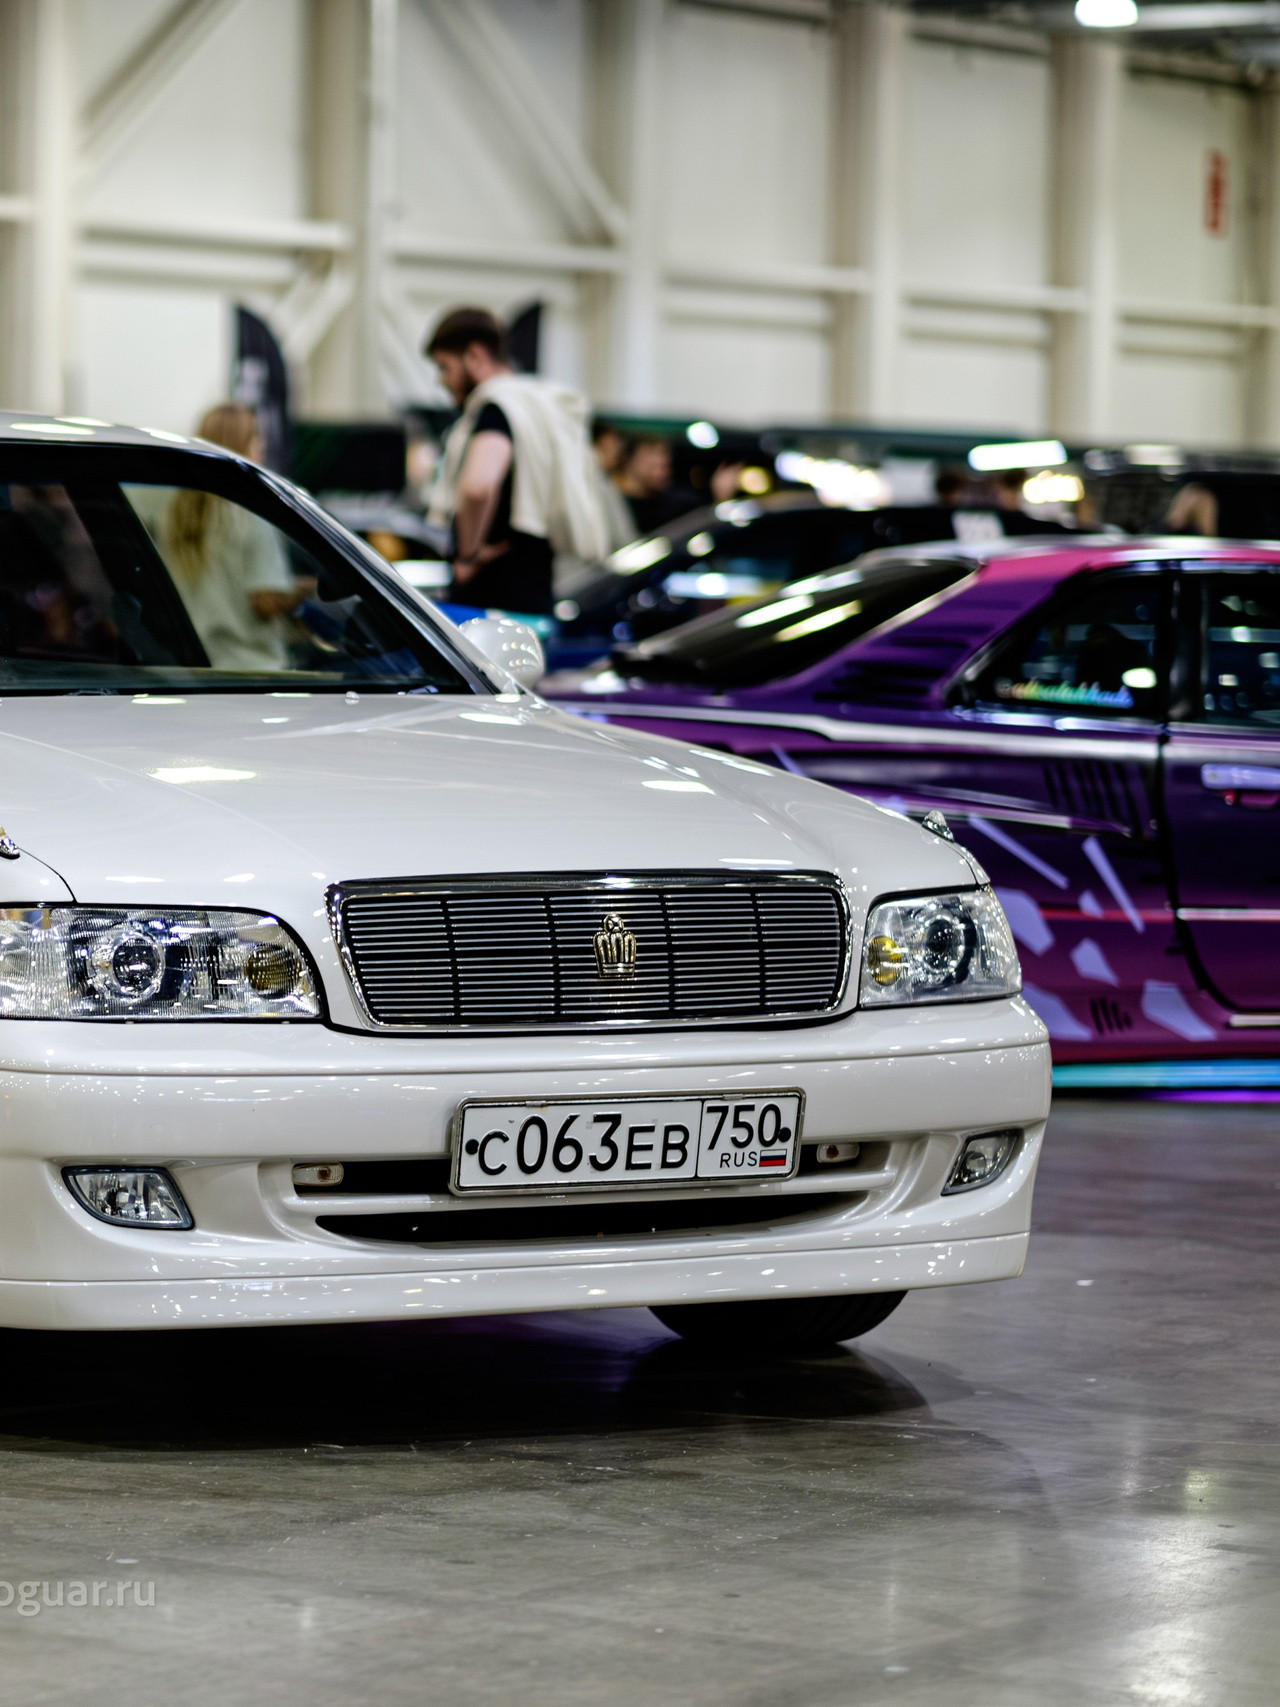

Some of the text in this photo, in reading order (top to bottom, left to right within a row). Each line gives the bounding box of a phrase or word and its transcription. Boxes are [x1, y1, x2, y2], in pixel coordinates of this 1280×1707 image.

[478, 1103, 783, 1176] C063EB 750
[719, 1150, 758, 1169] RUS
